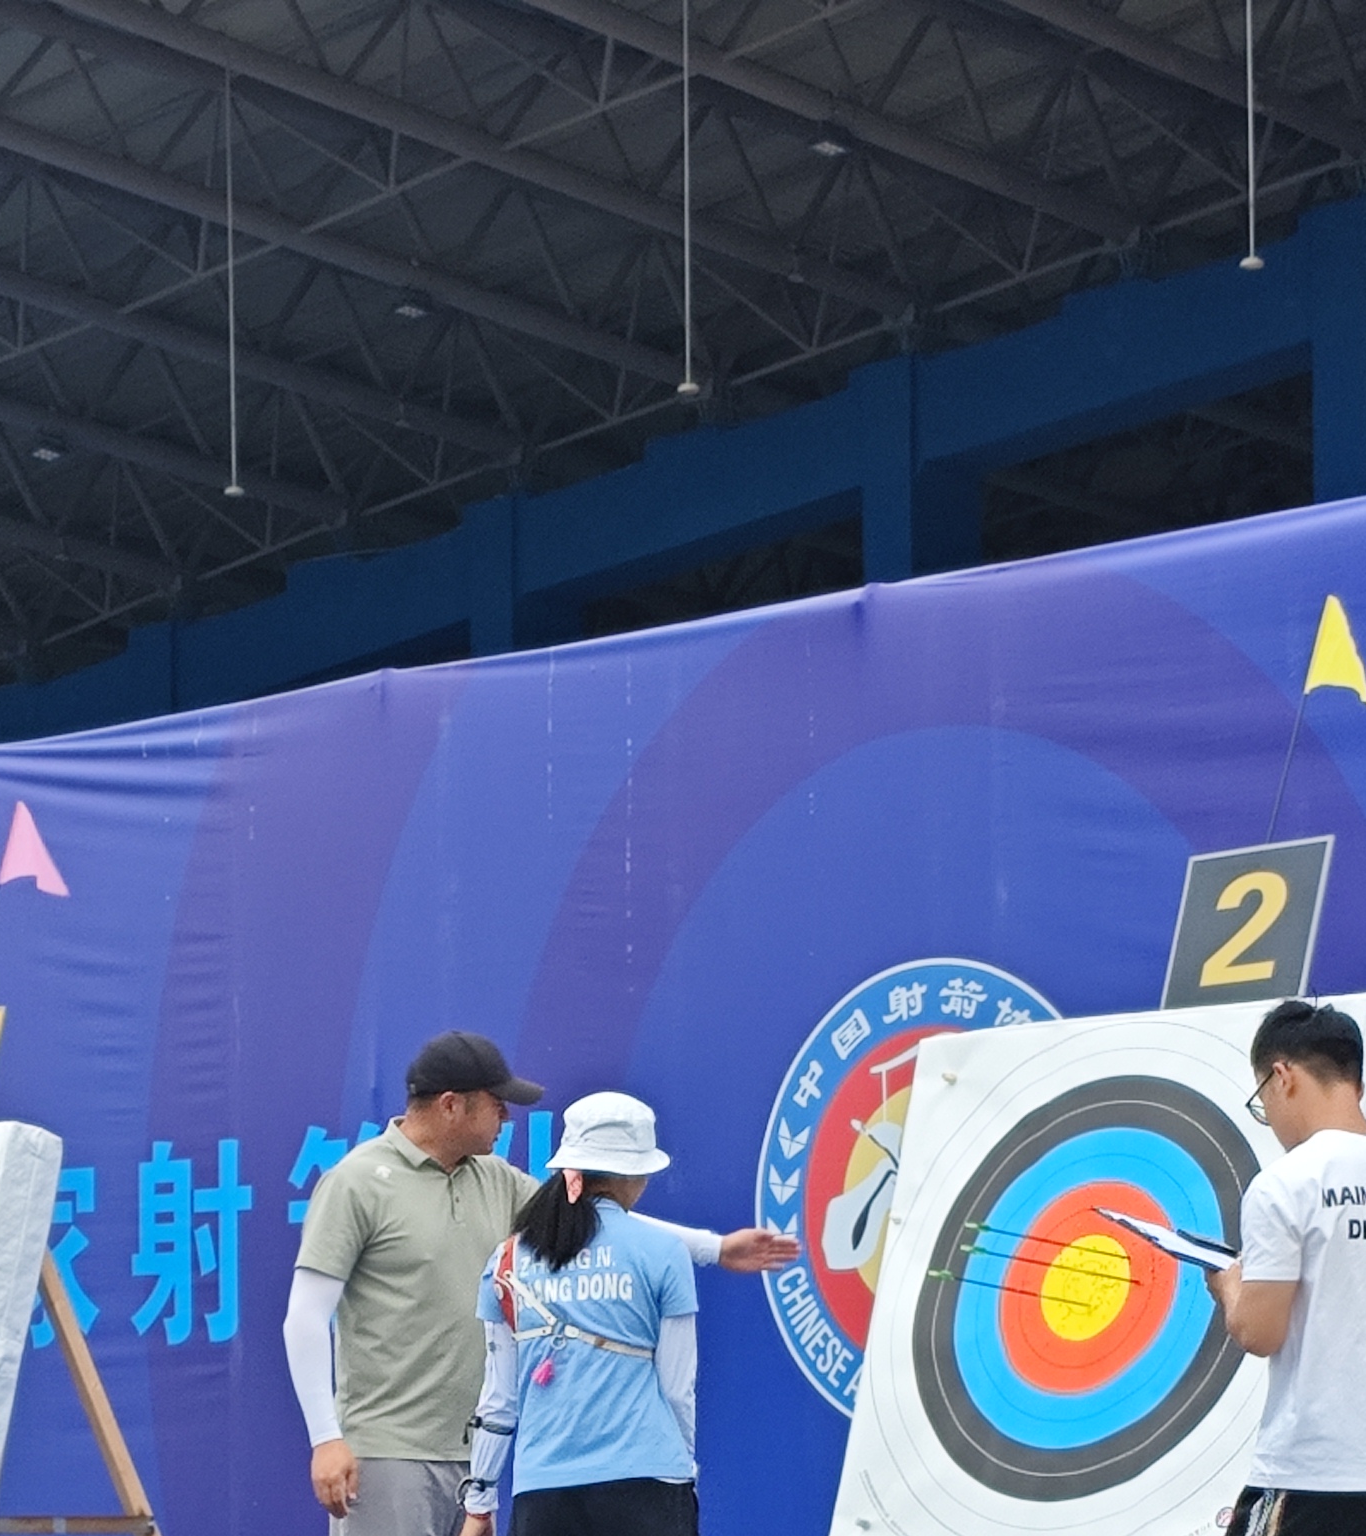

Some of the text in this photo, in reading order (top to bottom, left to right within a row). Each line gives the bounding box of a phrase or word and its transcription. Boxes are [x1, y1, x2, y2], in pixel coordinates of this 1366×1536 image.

[1199, 870, 1288, 988] 2
[576, 1272, 634, 1302] DONG
[775, 1265, 856, 1389] CHINESE
